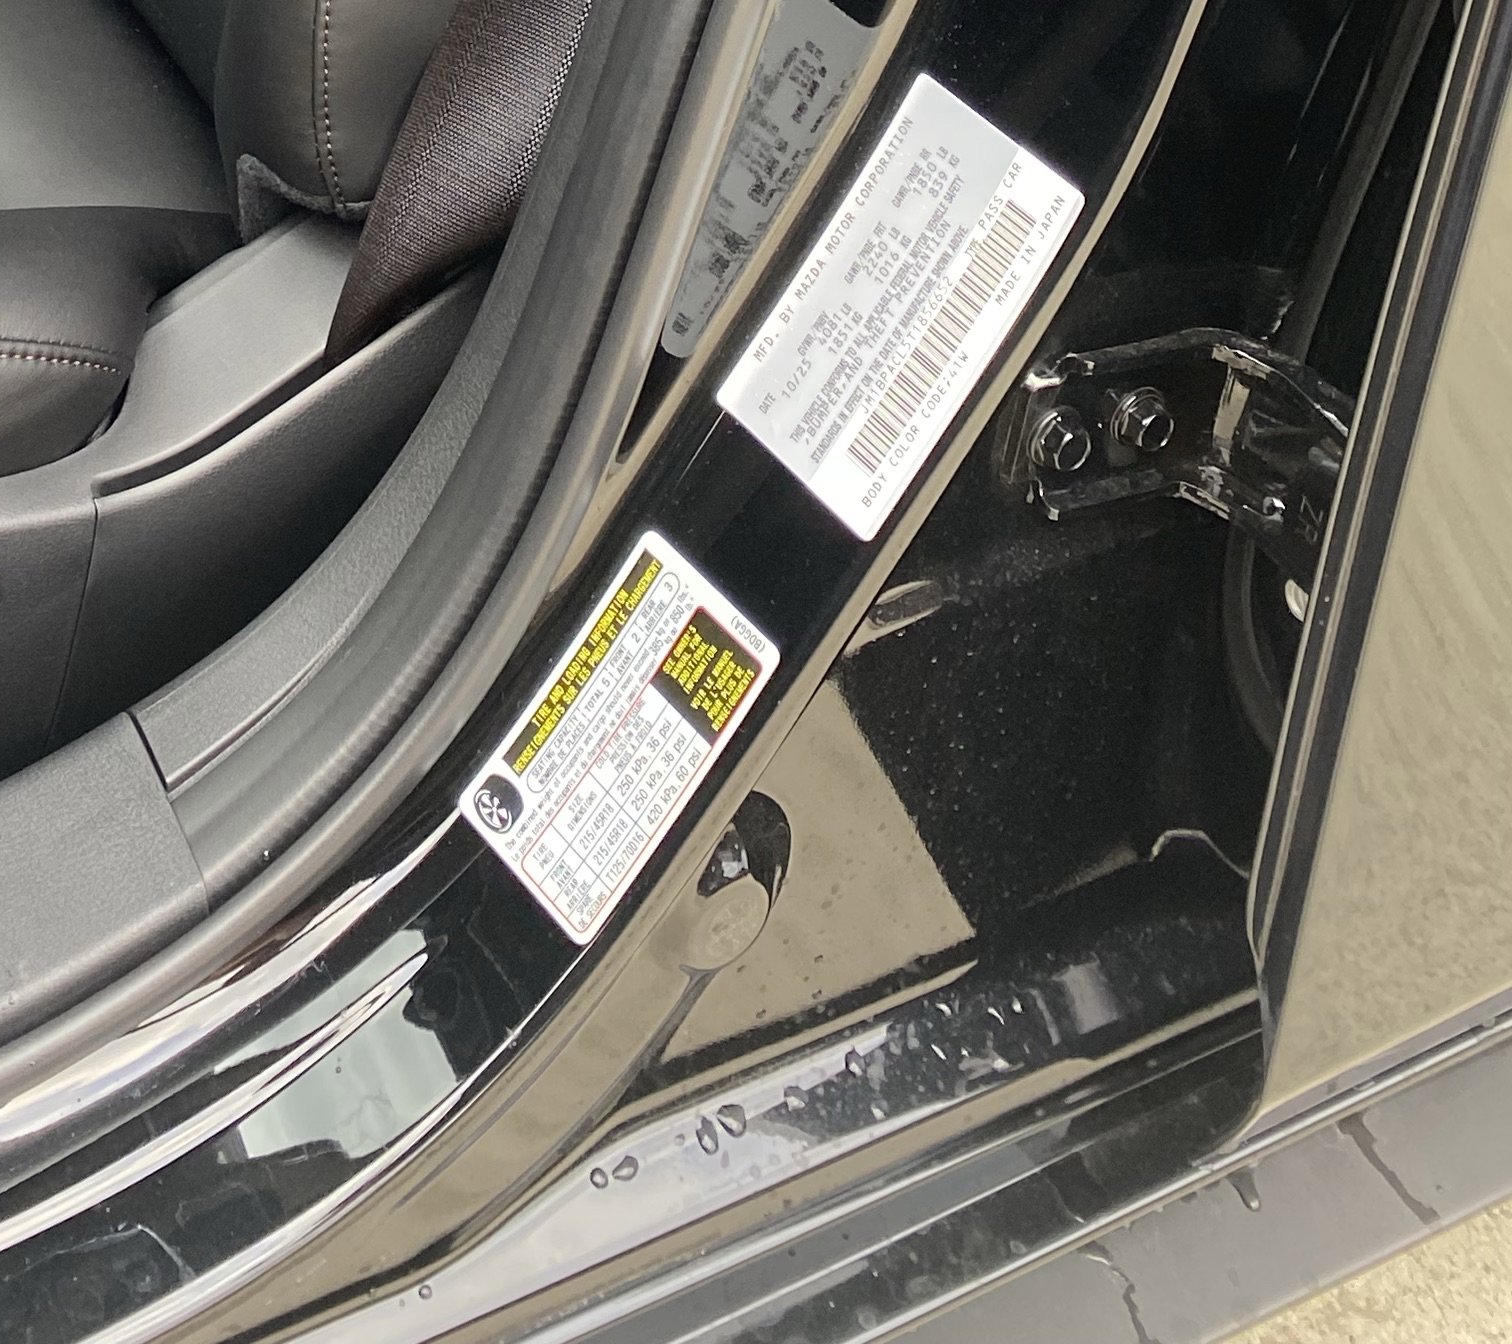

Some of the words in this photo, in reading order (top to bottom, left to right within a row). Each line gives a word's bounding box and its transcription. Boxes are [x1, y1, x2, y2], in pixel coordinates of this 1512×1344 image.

[752, 326, 779, 363] MFD.
[778, 303, 795, 324] BY
[794, 255, 826, 301] MAZDA
[824, 210, 856, 254] MOTOR
[852, 115, 915, 207] CORPORATION
[827, 321, 853, 356] 1851
[850, 310, 863, 326] KG
[873, 249, 900, 286] 1016
[898, 233, 912, 249] KG
[927, 169, 950, 198] 839
[947, 153, 960, 168] KG
[780, 356, 812, 401] 10/25
[816, 311, 842, 347] 4081
[839, 301, 852, 316] LB
[861, 239, 889, 277] 2240
[887, 225, 900, 240] LB
[911, 160, 938, 197] 1850
[936, 145, 949, 159] LB
[859, 273, 953, 416] JM1BPACL5T1856652
[977, 193, 1004, 230] PASS
[1001, 161, 1023, 189] CAR
[864, 306, 895, 349] THEFT
[893, 218, 952, 304] PREVENTION
[789, 423, 806, 444] THIS
[800, 393, 825, 427] VEHICLE
[820, 356, 850, 398] CONFORMS
[844, 345, 857, 359] TO
[852, 331, 866, 348] ALL
[862, 288, 894, 332] APPLICABLE
[889, 258, 913, 291] FEDERAL
[908, 231, 930, 260] MOTOR
[924, 201, 948, 233] VEHICLE
[942, 174, 965, 204] SAFETY
[809, 419, 842, 465] STANDARDS
[837, 409, 849, 423] IN
[843, 384, 865, 413] EFFECT
[860, 372, 873, 388] ON
[868, 357, 883, 375] THE
[878, 337, 896, 360] DATE
[891, 325, 904, 340] OF
[898, 274, 936, 330] MANUFACTURE
[930, 249, 952, 278] SHOWN
[861, 470, 888, 508] BODY
[887, 422, 920, 468] COLOR
[993, 269, 1021, 306] MADE
[1019, 244, 1036, 264] IN
[1033, 194, 1067, 240] JAPAN
[758, 391, 776, 415] DATE
[640, 599, 656, 619] REAR
[664, 581, 673, 592] 3
[630, 632, 641, 643] 2
[648, 636, 664, 657] 385
[669, 604, 685, 624] 850
[728, 613, 767, 654] (BDGGA)
[512, 700, 565, 775] RENSEIGNEMENTS
[562, 684, 578, 705] SUR
[574, 665, 591, 687] LES
[587, 637, 610, 667] PNEUS
[605, 624, 618, 640] ET
[614, 609, 628, 625] LE
[623, 559, 662, 611] CHARGEMENT
[531, 701, 552, 729] TIRE
[548, 683, 565, 705] AND
[561, 645, 591, 686] LOADING
[587, 588, 630, 646] INFORMATION
[609, 644, 627, 668] FRONT
[615, 650, 634, 675] AVANT
[661, 656, 676, 675] SEE
[669, 648, 692, 679] MANUAL
[688, 632, 703, 650] FOR
[676, 640, 709, 686] ADDITIONAL
[682, 644, 719, 695] INFORMATION
[689, 688, 707, 711] VOIR
[703, 676, 714, 690] LE
[711, 647, 734, 678] MANUEL
[584, 686, 603, 713] TOTAL
[601, 676, 610, 687] 5
[700, 696, 712, 711] DE
[706, 698, 724, 720] POUR
[720, 677, 737, 699] PLUS
[733, 664, 745, 679] DE
[710, 667, 756, 732] RENSEIGNEMENTS
[531, 746, 555, 780] SEATING
[553, 714, 579, 749] CAPACITY
[564, 721, 585, 749] PLACES
[594, 749, 610, 770] COLD
[608, 731, 622, 749] TIRE
[608, 729, 634, 764] PRESSION
[631, 714, 644, 730] DES
[614, 749, 632, 773] PNEUS
[634, 719, 652, 743] FROID
[616, 772, 634, 797] 250
[645, 735, 660, 753] 36
[656, 717, 675, 740] psi
[630, 787, 649, 812] 250
[660, 749, 675, 768] 36
[671, 731, 689, 754] psi
[645, 802, 664, 827] 420
[675, 764, 690, 783] 60
[686, 746, 704, 769] psi
[566, 789, 597, 831] DIMENSIONS
[567, 792, 583, 813] SIZE
[579, 801, 614, 850] 215/45R18
[532, 841, 548, 862] TIRE
[538, 848, 554, 870] PNEU
[592, 817, 628, 866] 215/45R18
[605, 830, 645, 884] T125/70D16
[550, 858, 567, 882] FRONT
[556, 865, 574, 890] AVANT
